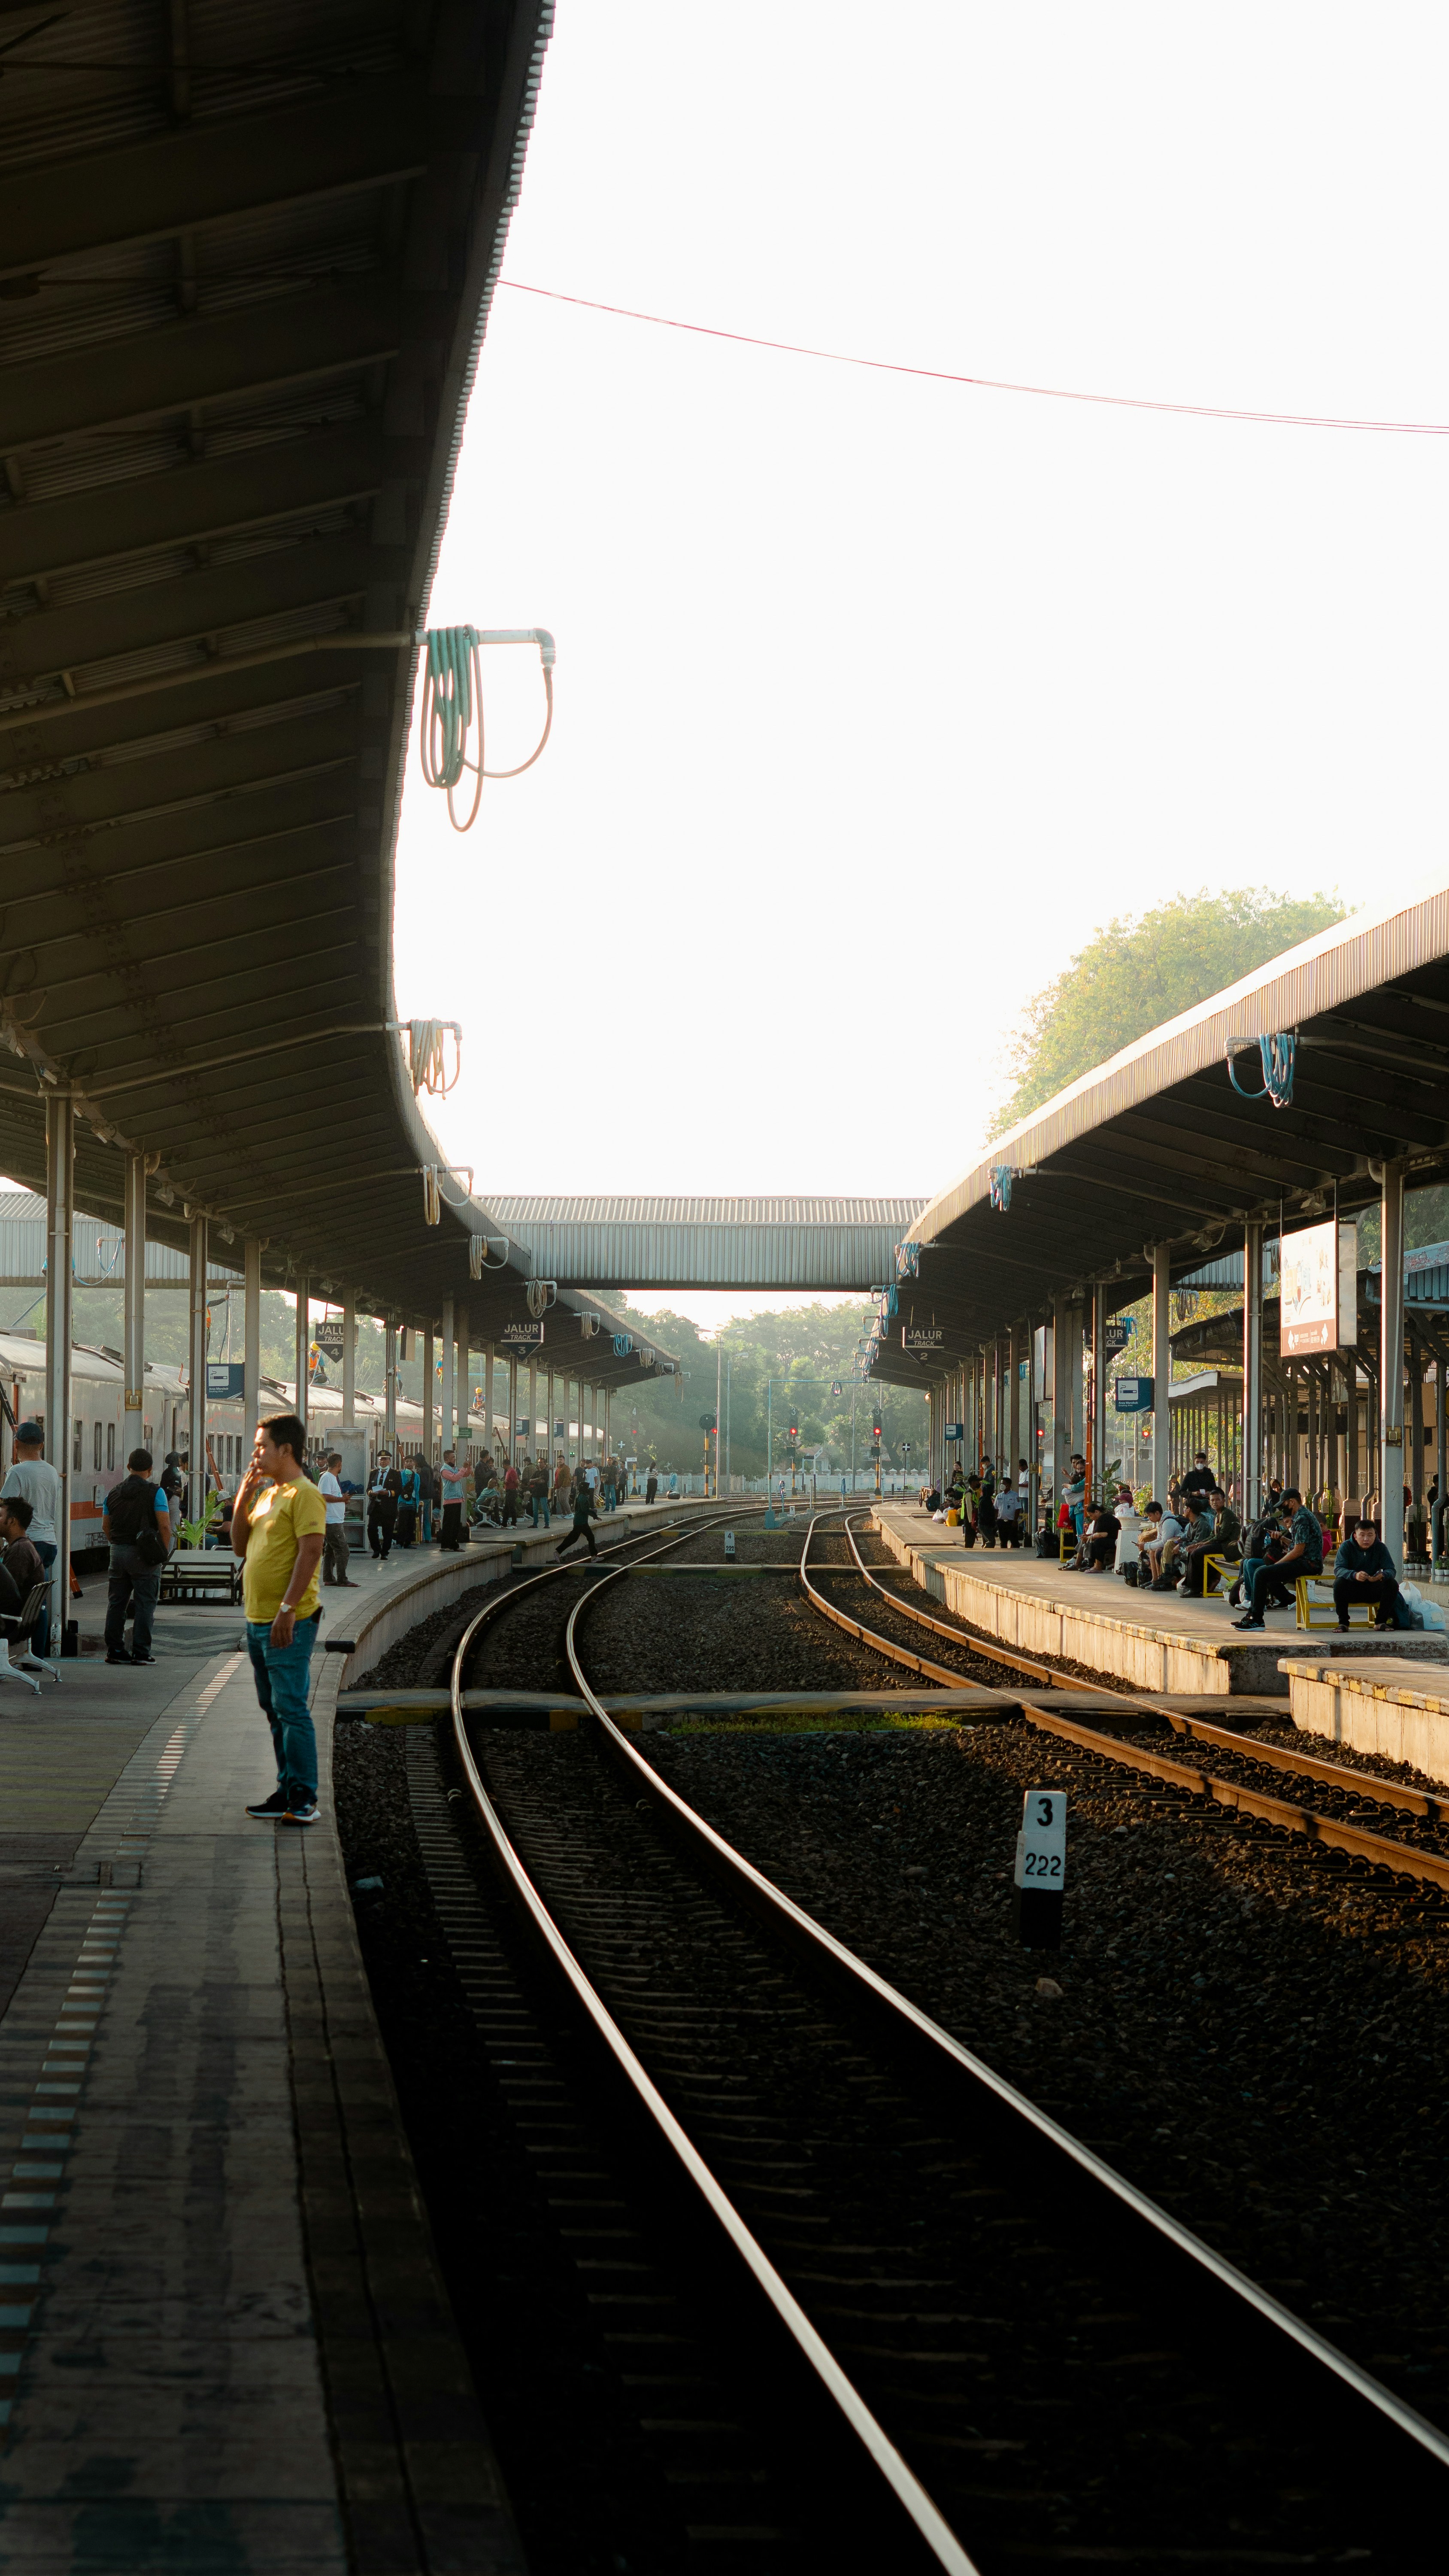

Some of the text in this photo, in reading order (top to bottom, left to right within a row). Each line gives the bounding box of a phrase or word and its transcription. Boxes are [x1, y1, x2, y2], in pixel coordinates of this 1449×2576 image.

[318, 1326, 343, 1335] JALU
[504, 1324, 539, 1333] JALUR
[908, 1330, 942, 1339] JALUR
[632, 1407, 637, 1416] 4
[713, 1407, 717, 1416] 3
[791, 1407, 796, 1416] 3
[875, 1407, 879, 1415] 3
[1037, 1798, 1053, 1827] 3
[1025, 1853, 1061, 1877] 222
